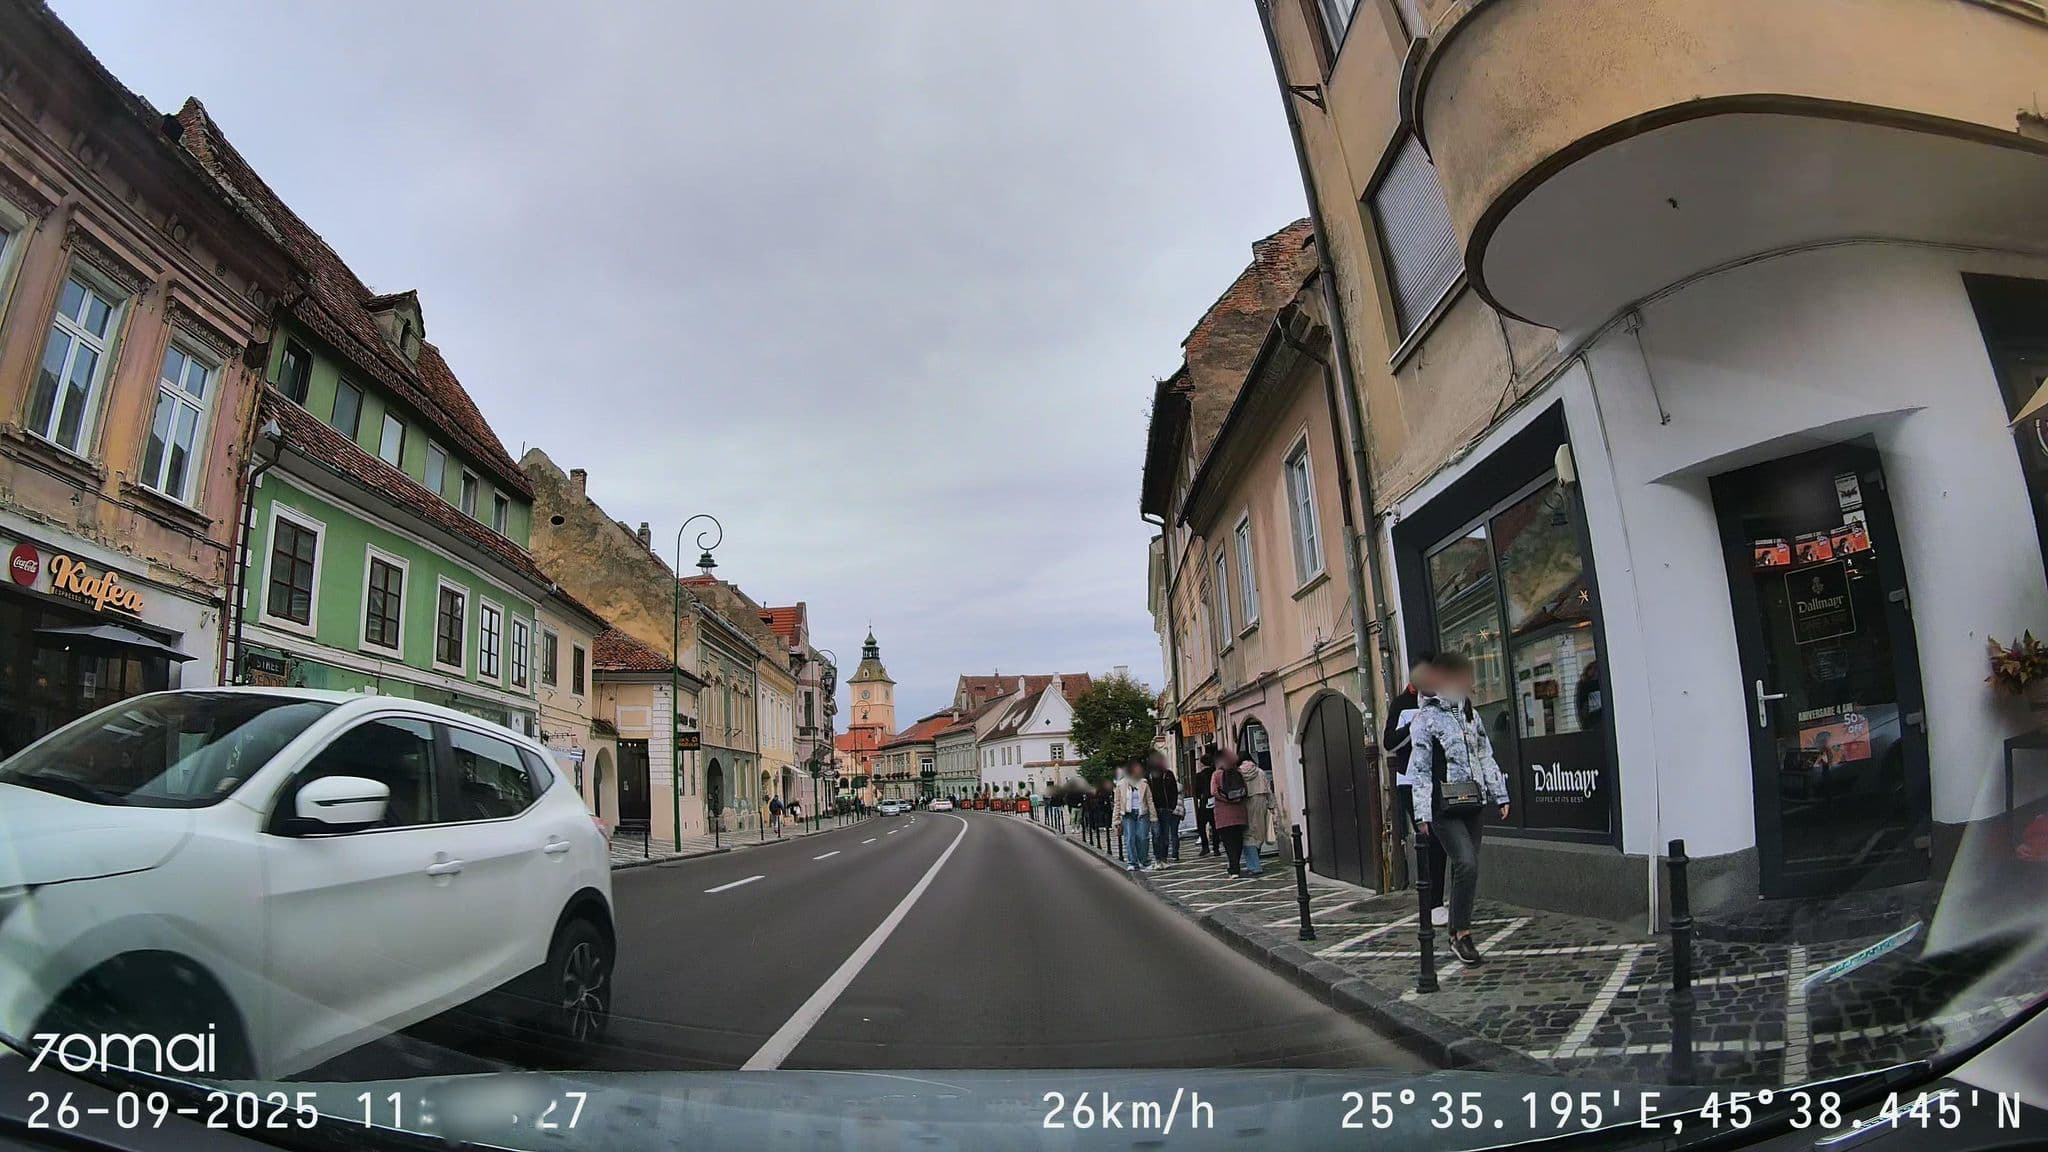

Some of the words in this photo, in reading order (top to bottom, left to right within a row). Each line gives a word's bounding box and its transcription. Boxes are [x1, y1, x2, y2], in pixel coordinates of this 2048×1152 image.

[51, 555, 144, 611] Kafea
[1796, 595, 1843, 613] Dallmayr
[1532, 762, 1599, 798] Dallmayr
